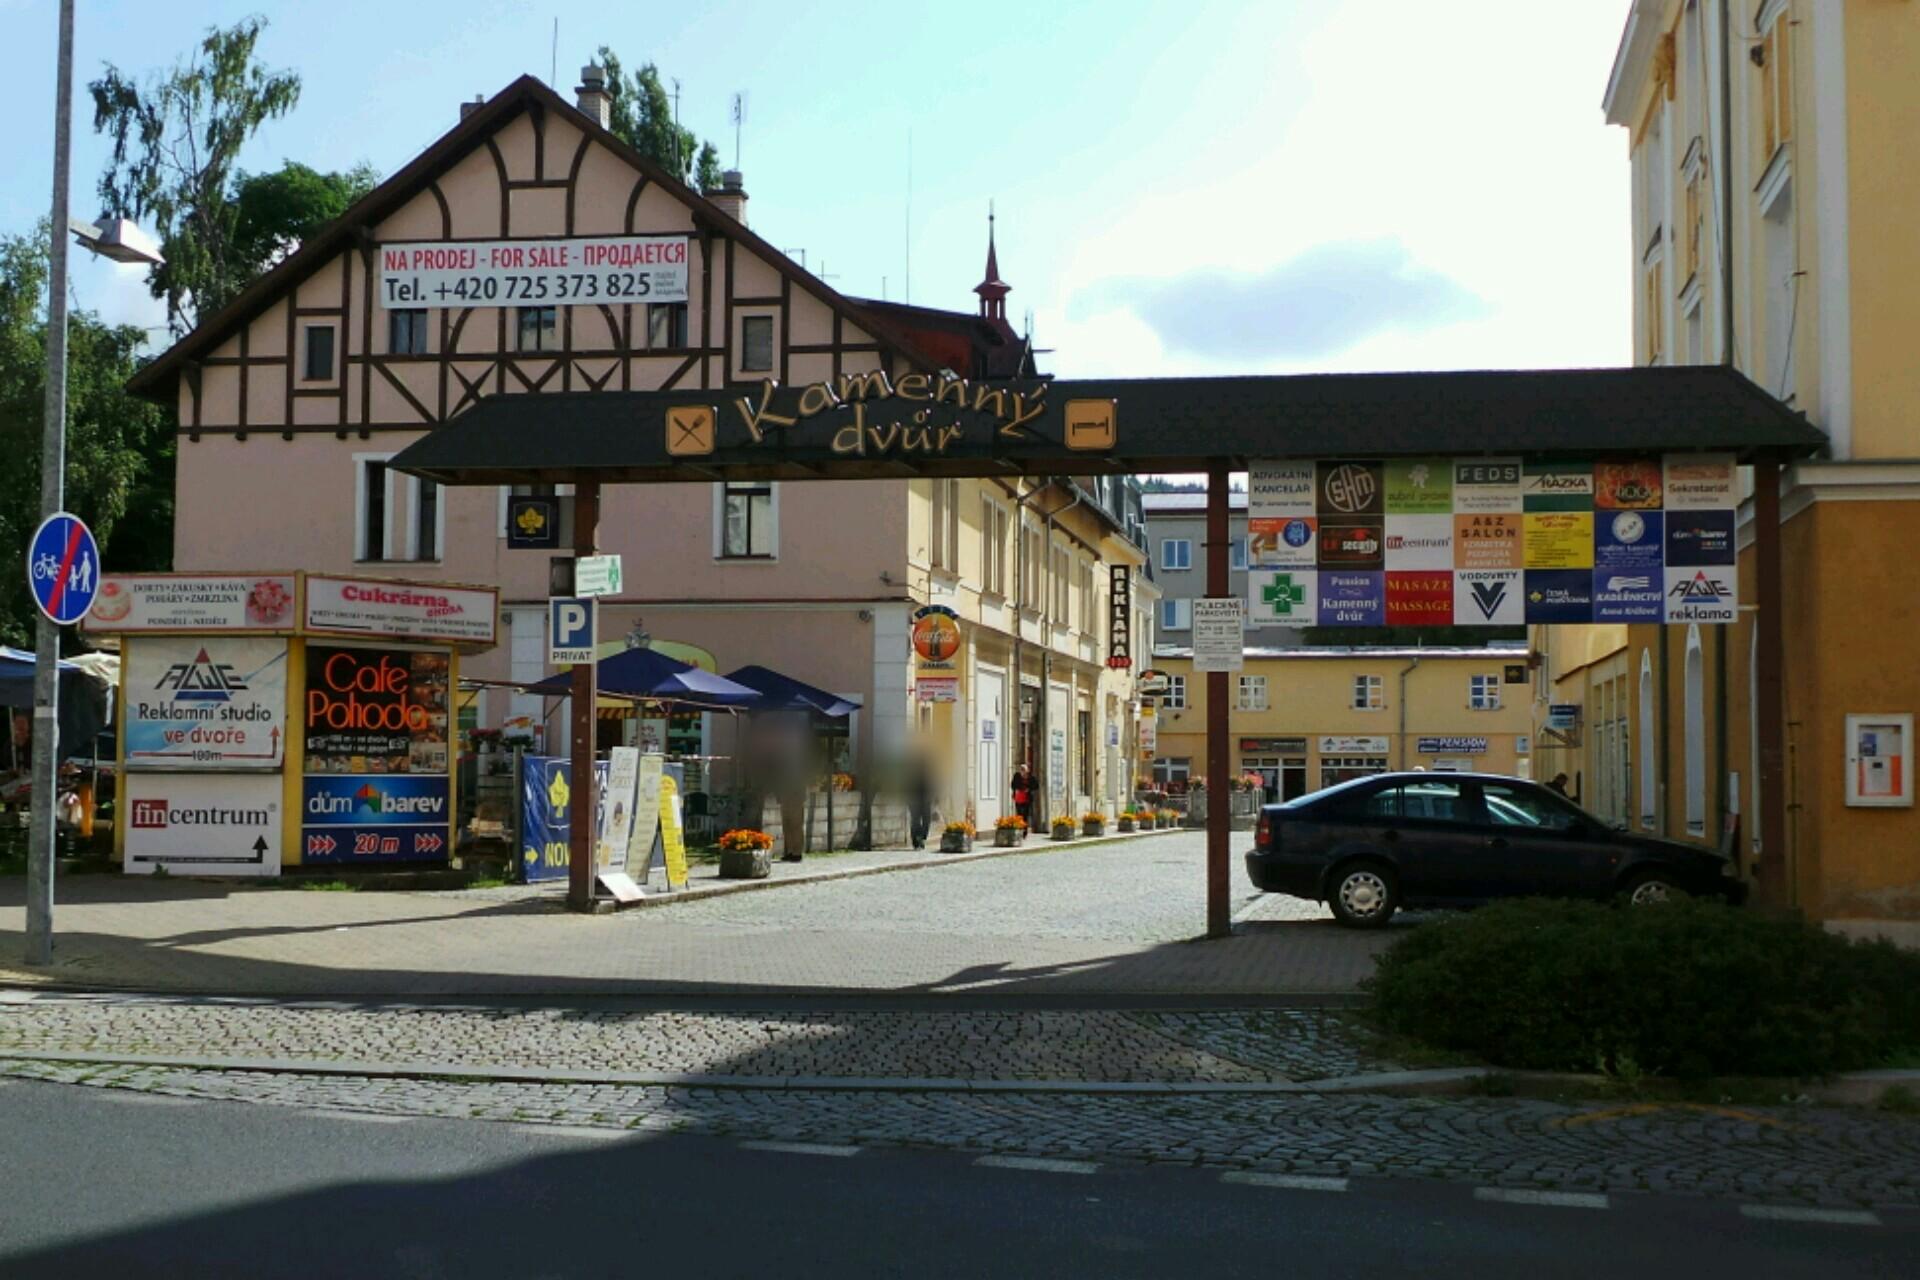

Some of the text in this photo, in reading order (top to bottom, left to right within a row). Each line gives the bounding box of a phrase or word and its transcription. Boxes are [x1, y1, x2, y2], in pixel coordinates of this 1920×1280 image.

[385, 250, 407, 271] NA
[413, 249, 476, 271] PRODEJ
[491, 248, 524, 268] FOR
[528, 246, 568, 268] SALE
[584, 243, 685, 269] ПРОДАЕТСЯ
[385, 277, 427, 302] Tel.
[433, 276, 498, 301] +420
[504, 275, 548, 299] 725
[555, 273, 598, 298] 373
[606, 272, 650, 297] 825
[735, 368, 1048, 443] Kamenný
[831, 403, 965, 456] dvůr
[1460, 467, 1516, 481] FEDS
[1461, 528, 1516, 538] SALON
[341, 585, 450, 608] Cukrárna
[1388, 600, 1451, 612] MASSAGE
[1112, 567, 1127, 657] REKLAMA
[1669, 605, 1733, 621] reklama
[325, 652, 409, 694] Cafe
[138, 701, 272, 721] Reklamní studio
[308, 690, 428, 731] Pohoda
[163, 726, 246, 744] ve dvoře
[1439, 737, 1487, 748] PENSION
[134, 798, 269, 828] fincentrum
[309, 791, 443, 813] dům barev
[353, 833, 400, 854] 20 m
